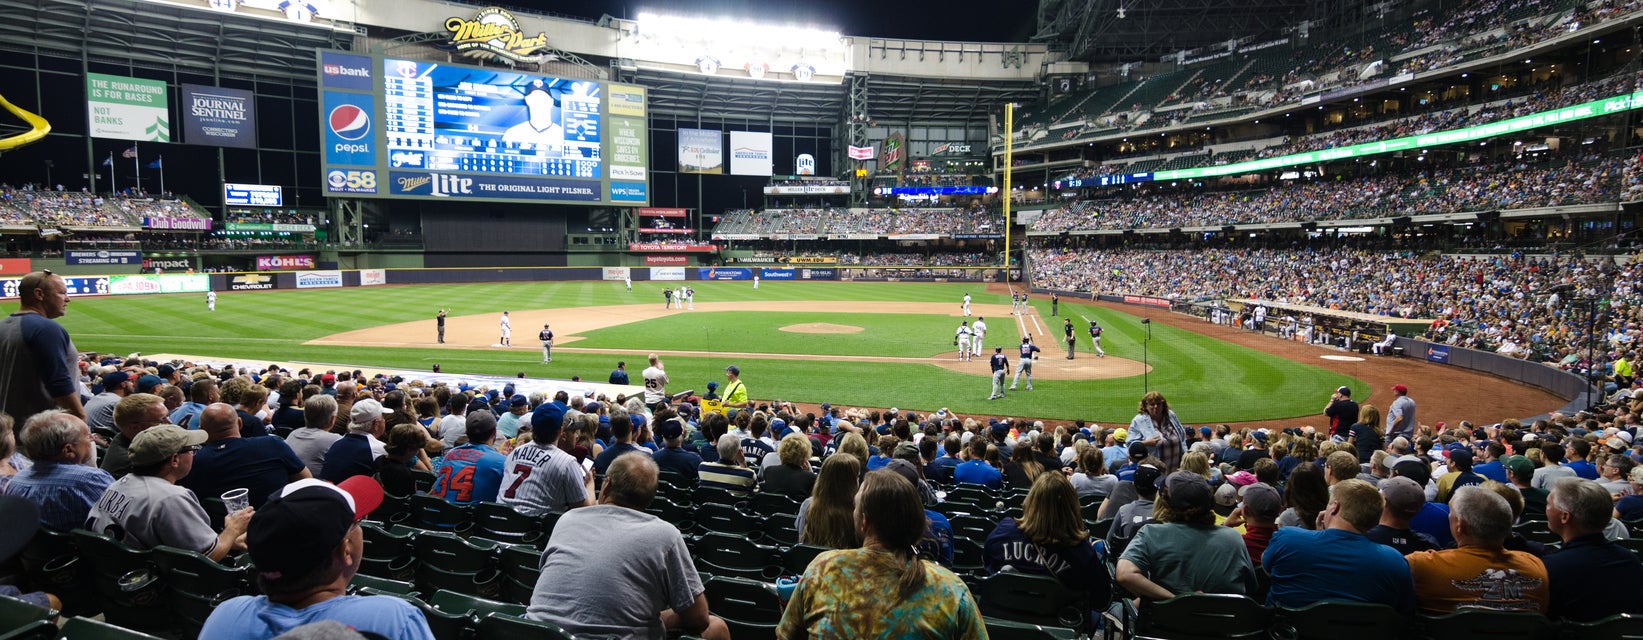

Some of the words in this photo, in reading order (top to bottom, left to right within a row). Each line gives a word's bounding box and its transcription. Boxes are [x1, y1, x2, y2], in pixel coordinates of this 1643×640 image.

[445, 17, 511, 41] Miller
[497, 28, 548, 51] Park
[91, 79, 109, 90] THE
[111, 81, 163, 95] RUNAROUND
[92, 88, 103, 98] IS
[104, 89, 122, 100] FOR
[124, 92, 153, 103] BASES
[94, 106, 111, 116] NOT
[192, 98, 246, 112] JOURNAL
[1604, 99, 1625, 112] Pick
[192, 107, 247, 120] SENTINEL
[94, 115, 124, 126] BANKS
[335, 143, 370, 154] pepsi
[948, 145, 971, 153] DECK
[798, 158, 813, 168] Lite
[346, 170, 377, 189] 58
[397, 176, 432, 192] Miller
[429, 172, 473, 197] Lite
[479, 183, 497, 191] THE
[498, 184, 535, 193] ORIGINAL
[537, 186, 560, 194] LIGHT
[561, 187, 594, 195] PILSNER.
[611, 188, 626, 196] WPS
[150, 217, 170, 229] Club
[171, 217, 207, 230] Goodwill
[149, 258, 190, 269] impact
[259, 257, 313, 267] KOHL'S
[645, 378, 657, 389] 25
[178, 413, 195, 430] 4
[511, 446, 552, 468] MAUER
[432, 465, 476, 502] 34
[504, 463, 532, 499] 7
[1002, 541, 1072, 575] LUCROY
